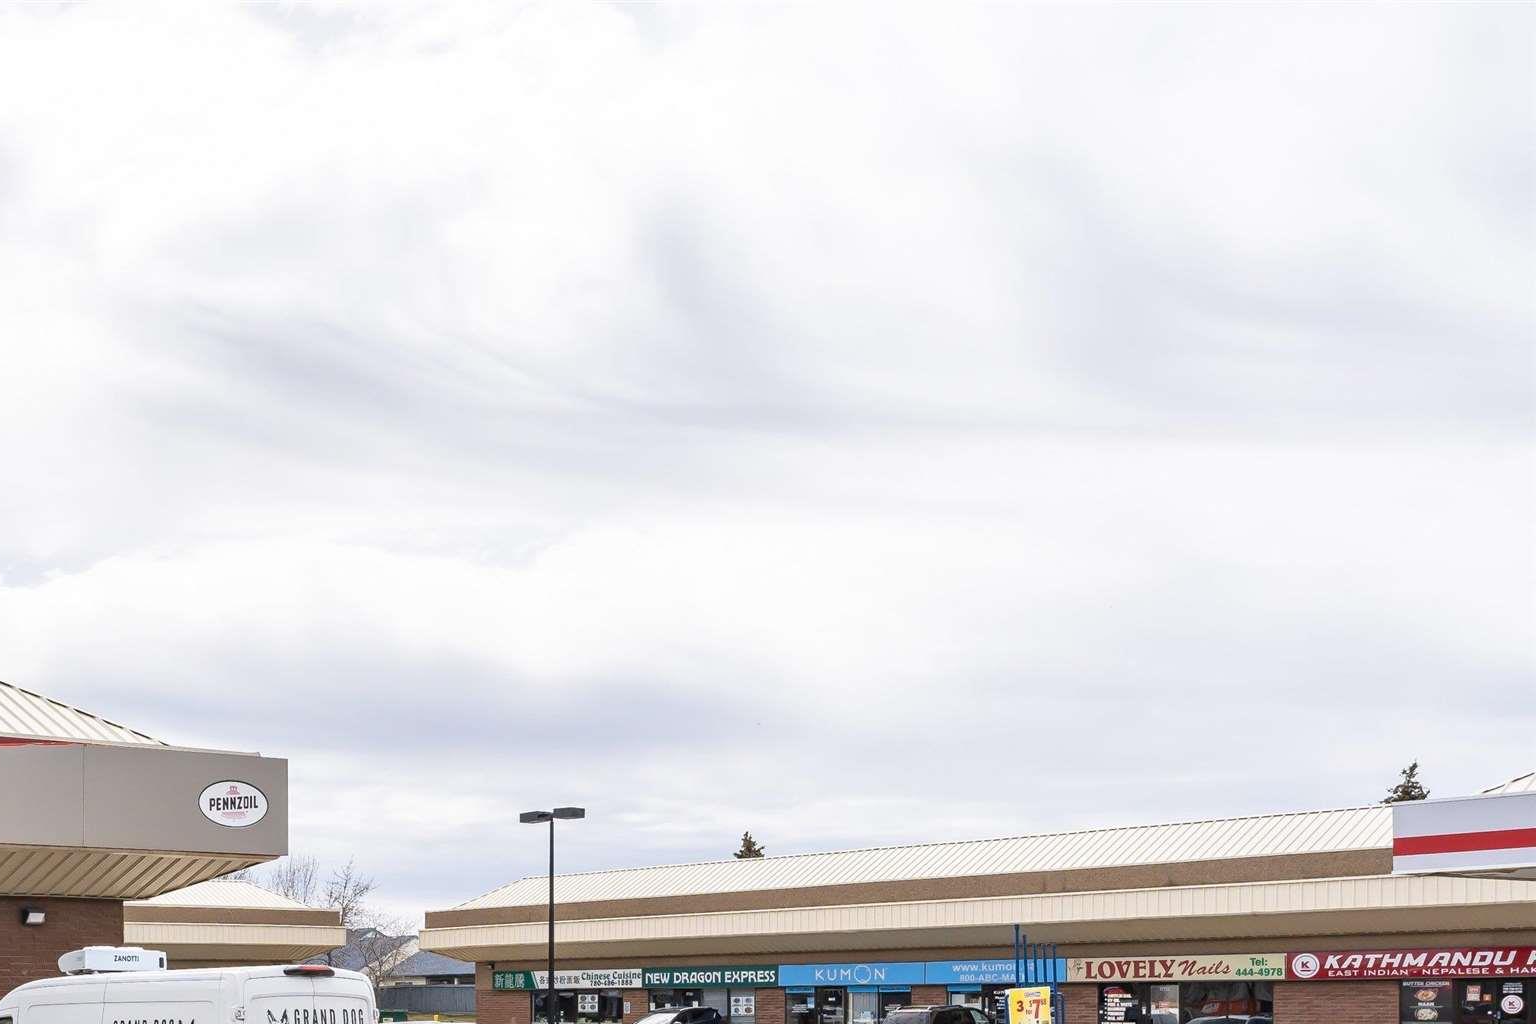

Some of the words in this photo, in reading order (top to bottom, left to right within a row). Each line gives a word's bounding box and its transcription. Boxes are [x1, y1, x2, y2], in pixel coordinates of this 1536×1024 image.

[209, 796, 258, 811] PENNZOIL
[1249, 958, 1268, 967] Tel:
[1324, 951, 1518, 969] KATHMANDU
[581, 971, 611, 981] Chinese
[612, 970, 642, 980] Cuisine
[815, 965, 885, 984] KUMON
[1085, 960, 1175, 979] LOVELY
[1178, 960, 1232, 976] Nails
[1235, 968, 1283, 977] 444-4978
[1422, 967, 1489, 975] NEPALESE
[645, 972, 670, 984] NEW
[673, 971, 721, 984] DRAGON
[725, 970, 776, 983] EXPRESS
[1016, 1000, 1024, 1012] 3
